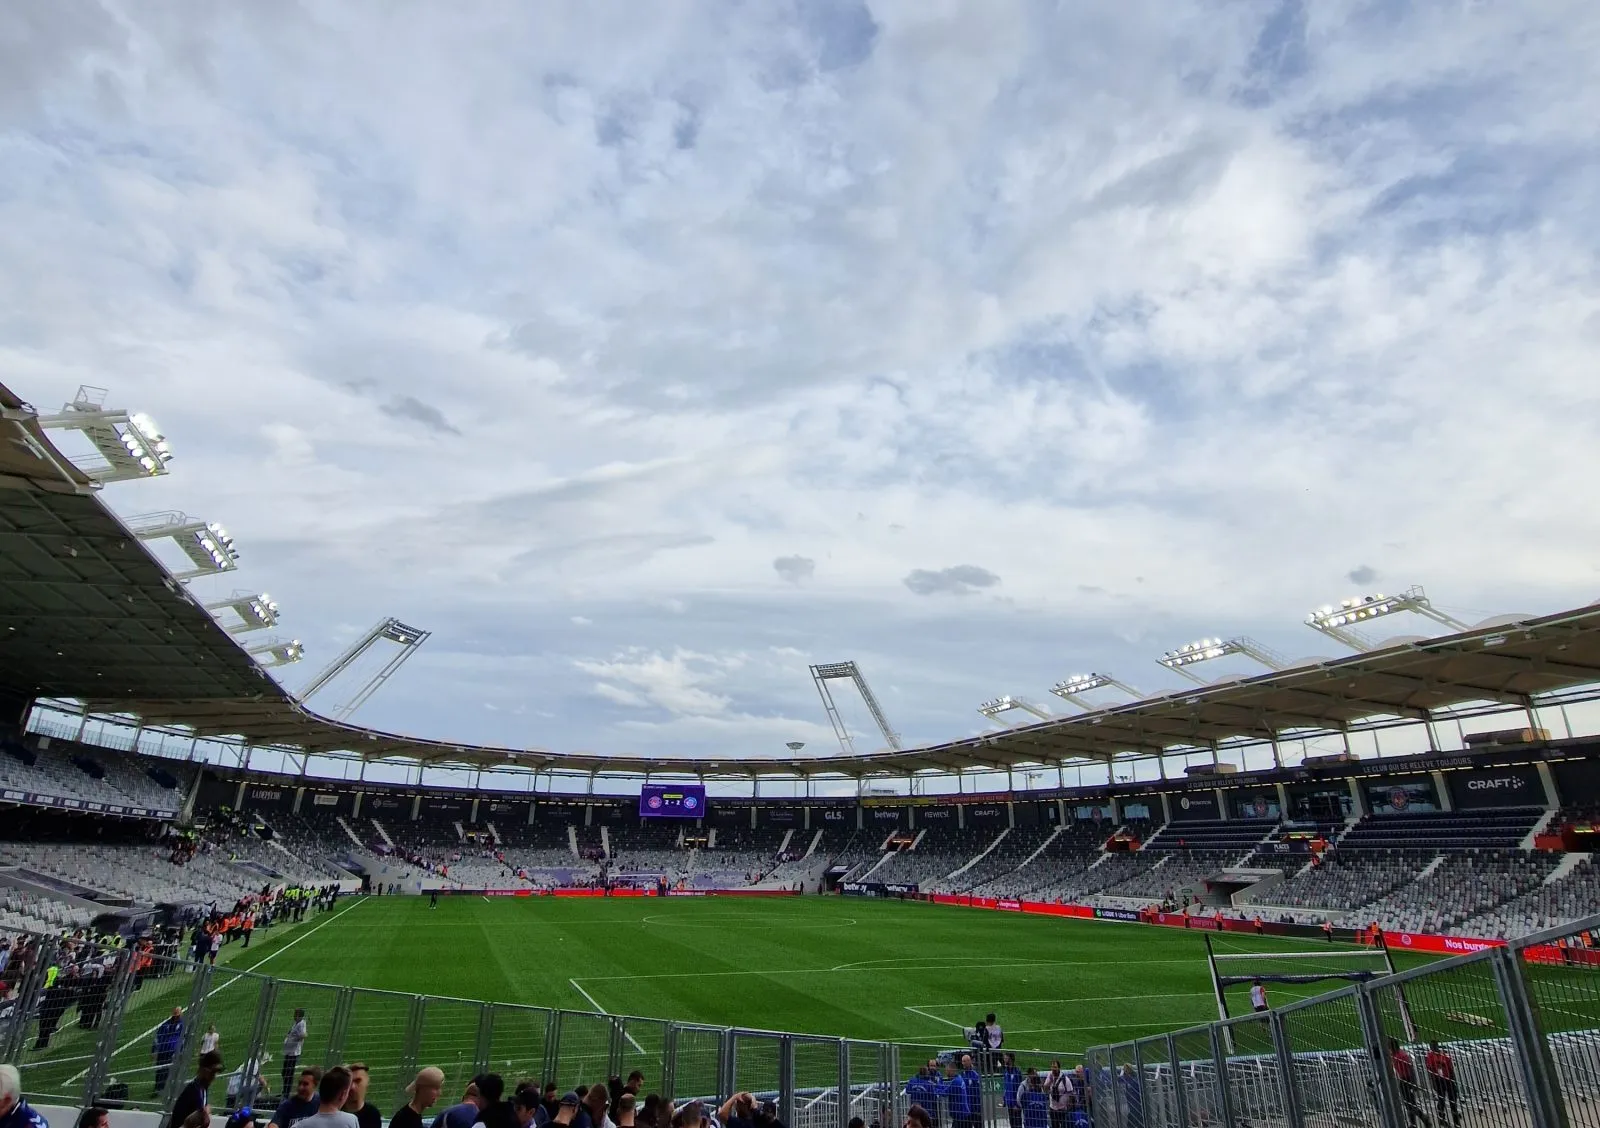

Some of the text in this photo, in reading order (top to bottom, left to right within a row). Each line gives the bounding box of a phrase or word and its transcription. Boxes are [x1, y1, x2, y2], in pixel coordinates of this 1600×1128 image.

[1467, 778, 1511, 790] CRAFT
[874, 810, 900, 820] betway
[1445, 939, 1462, 949] Nos
